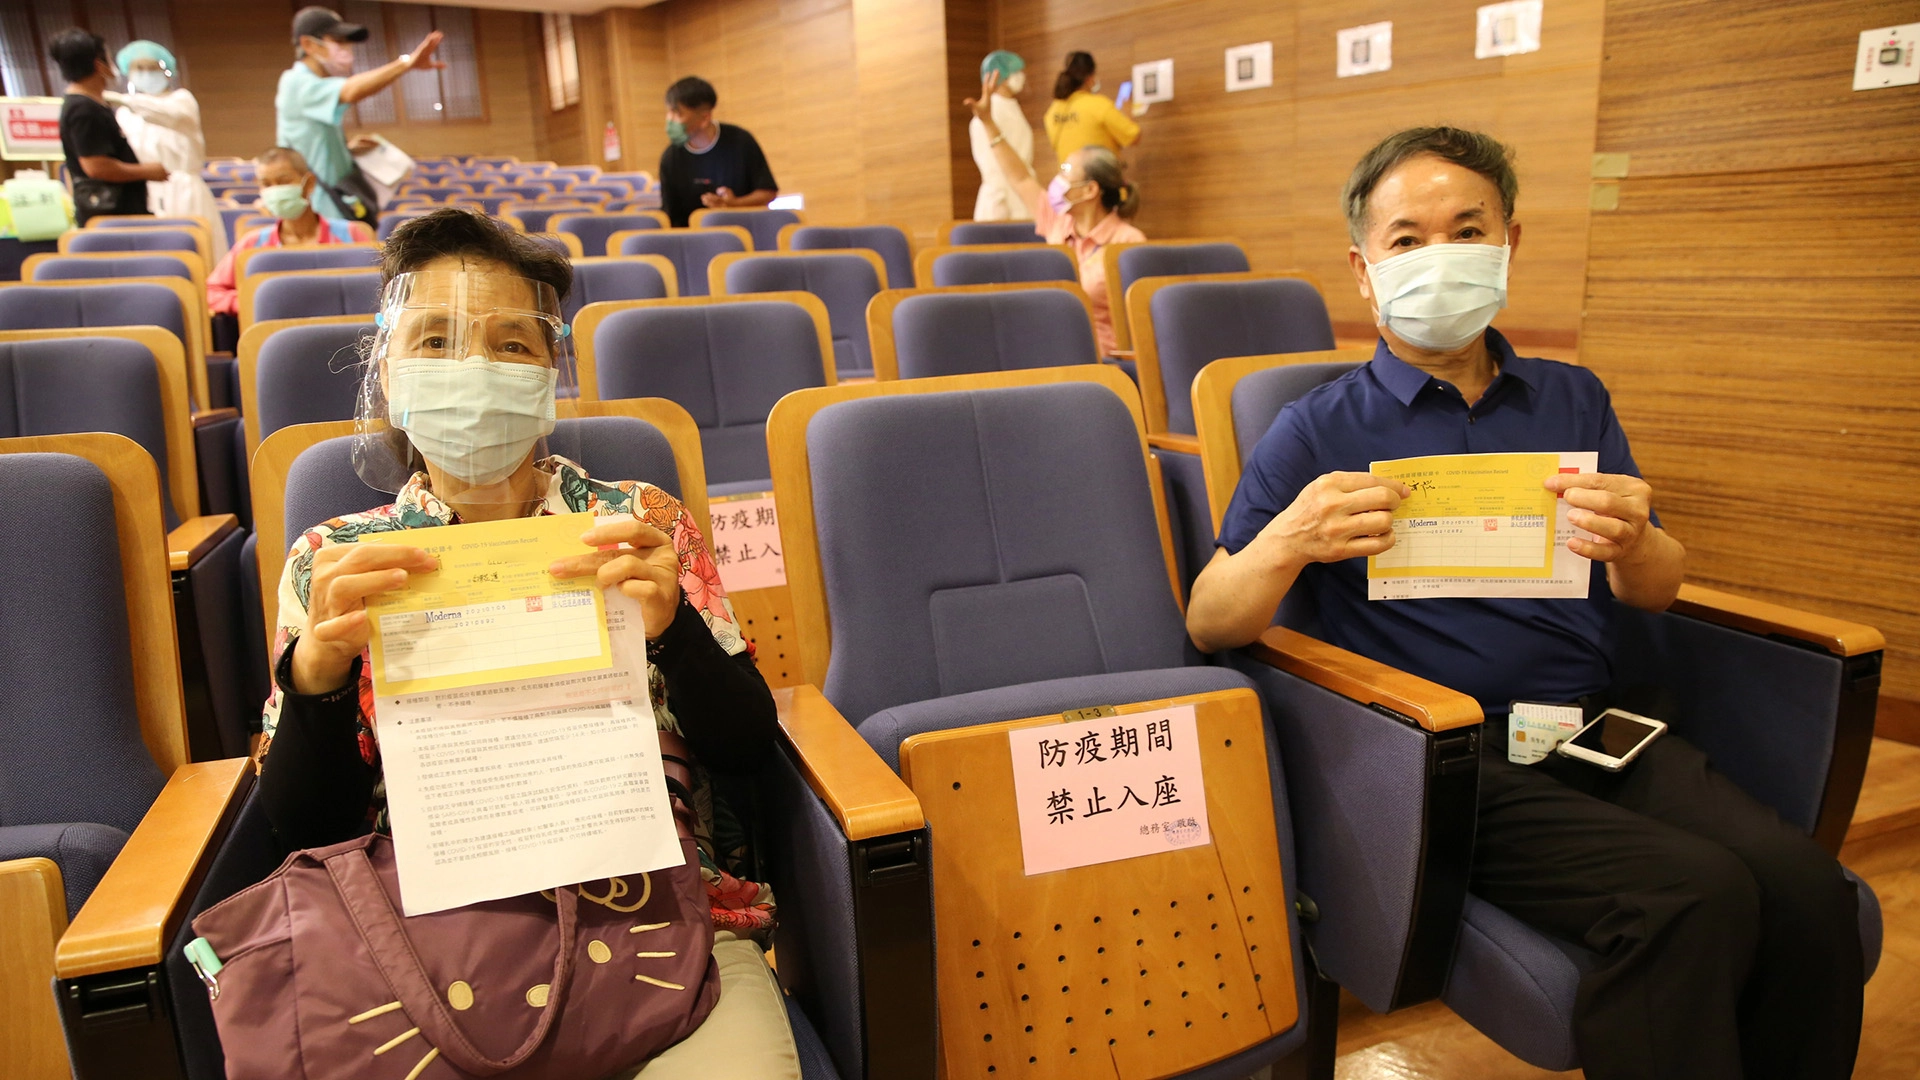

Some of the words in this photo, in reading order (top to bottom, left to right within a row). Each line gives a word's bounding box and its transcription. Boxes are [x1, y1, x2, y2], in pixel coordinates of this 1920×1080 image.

[1409, 519, 1438, 528] Moderna
[425, 610, 462, 624] Moderna
[1078, 707, 1102, 720] 1-3
[1039, 718, 1173, 769] 防疫期間
[1046, 775, 1182, 825] 禁止入座
